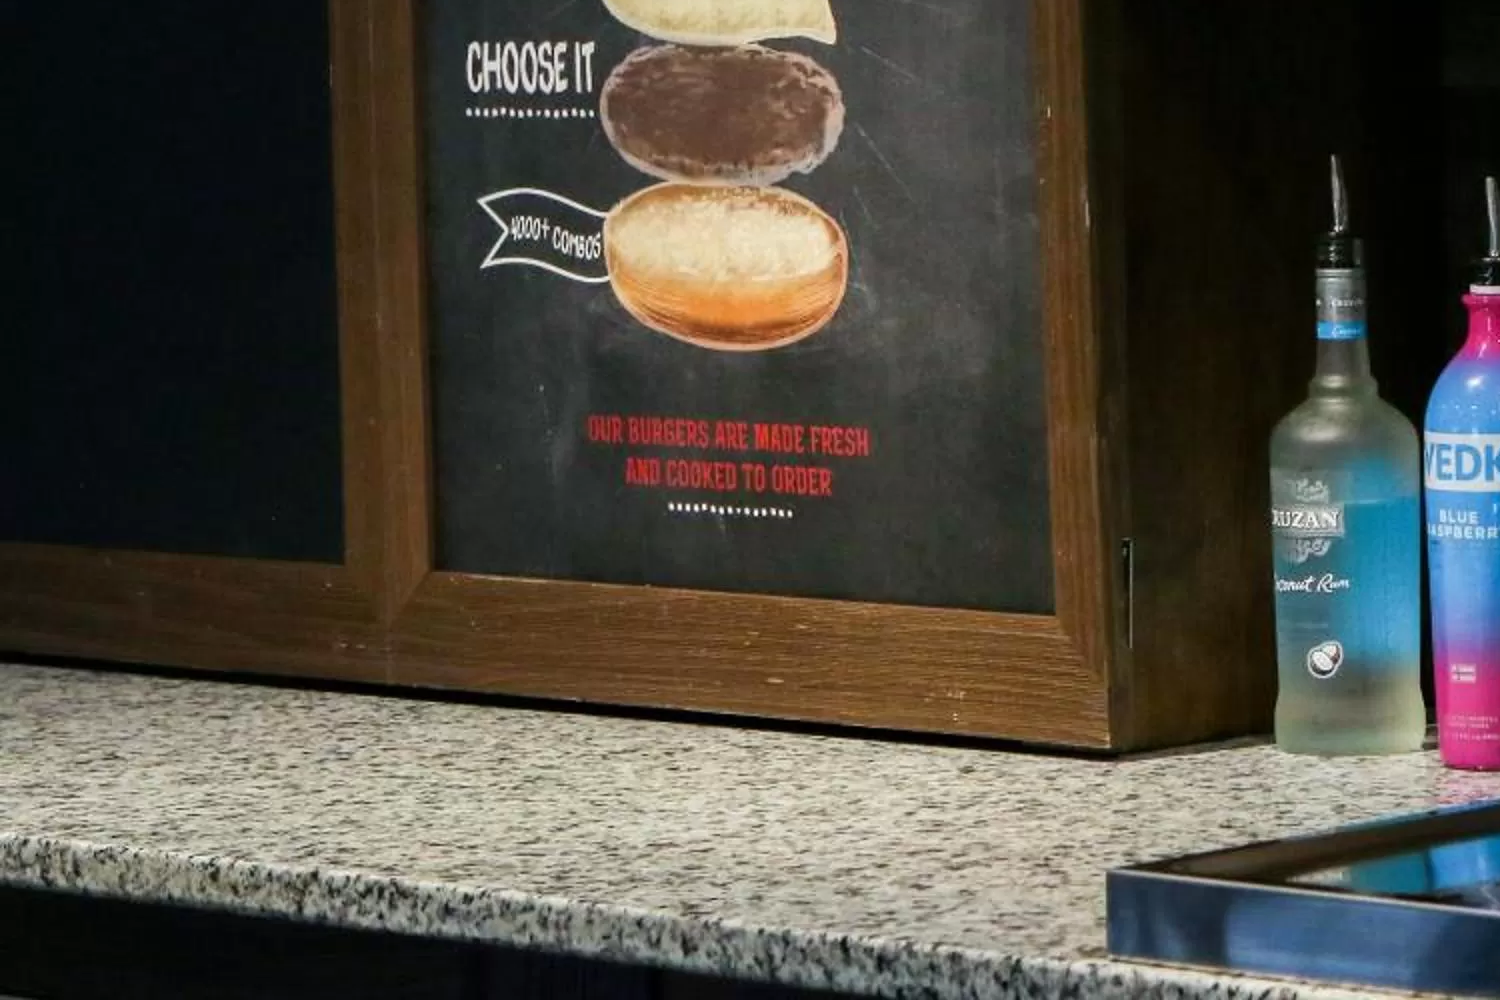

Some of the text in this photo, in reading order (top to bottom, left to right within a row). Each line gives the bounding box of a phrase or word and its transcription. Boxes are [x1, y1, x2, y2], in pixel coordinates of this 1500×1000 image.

[465, 41, 596, 95] CHOOSE IT
[510, 214, 601, 260] 4000+ COMBOS
[587, 415, 869, 455] OUR BURGERS ARE MADE FRESH
[626, 457, 832, 496] AND COOKED TO ORDER
[1440, 508, 1480, 523] BLUE
